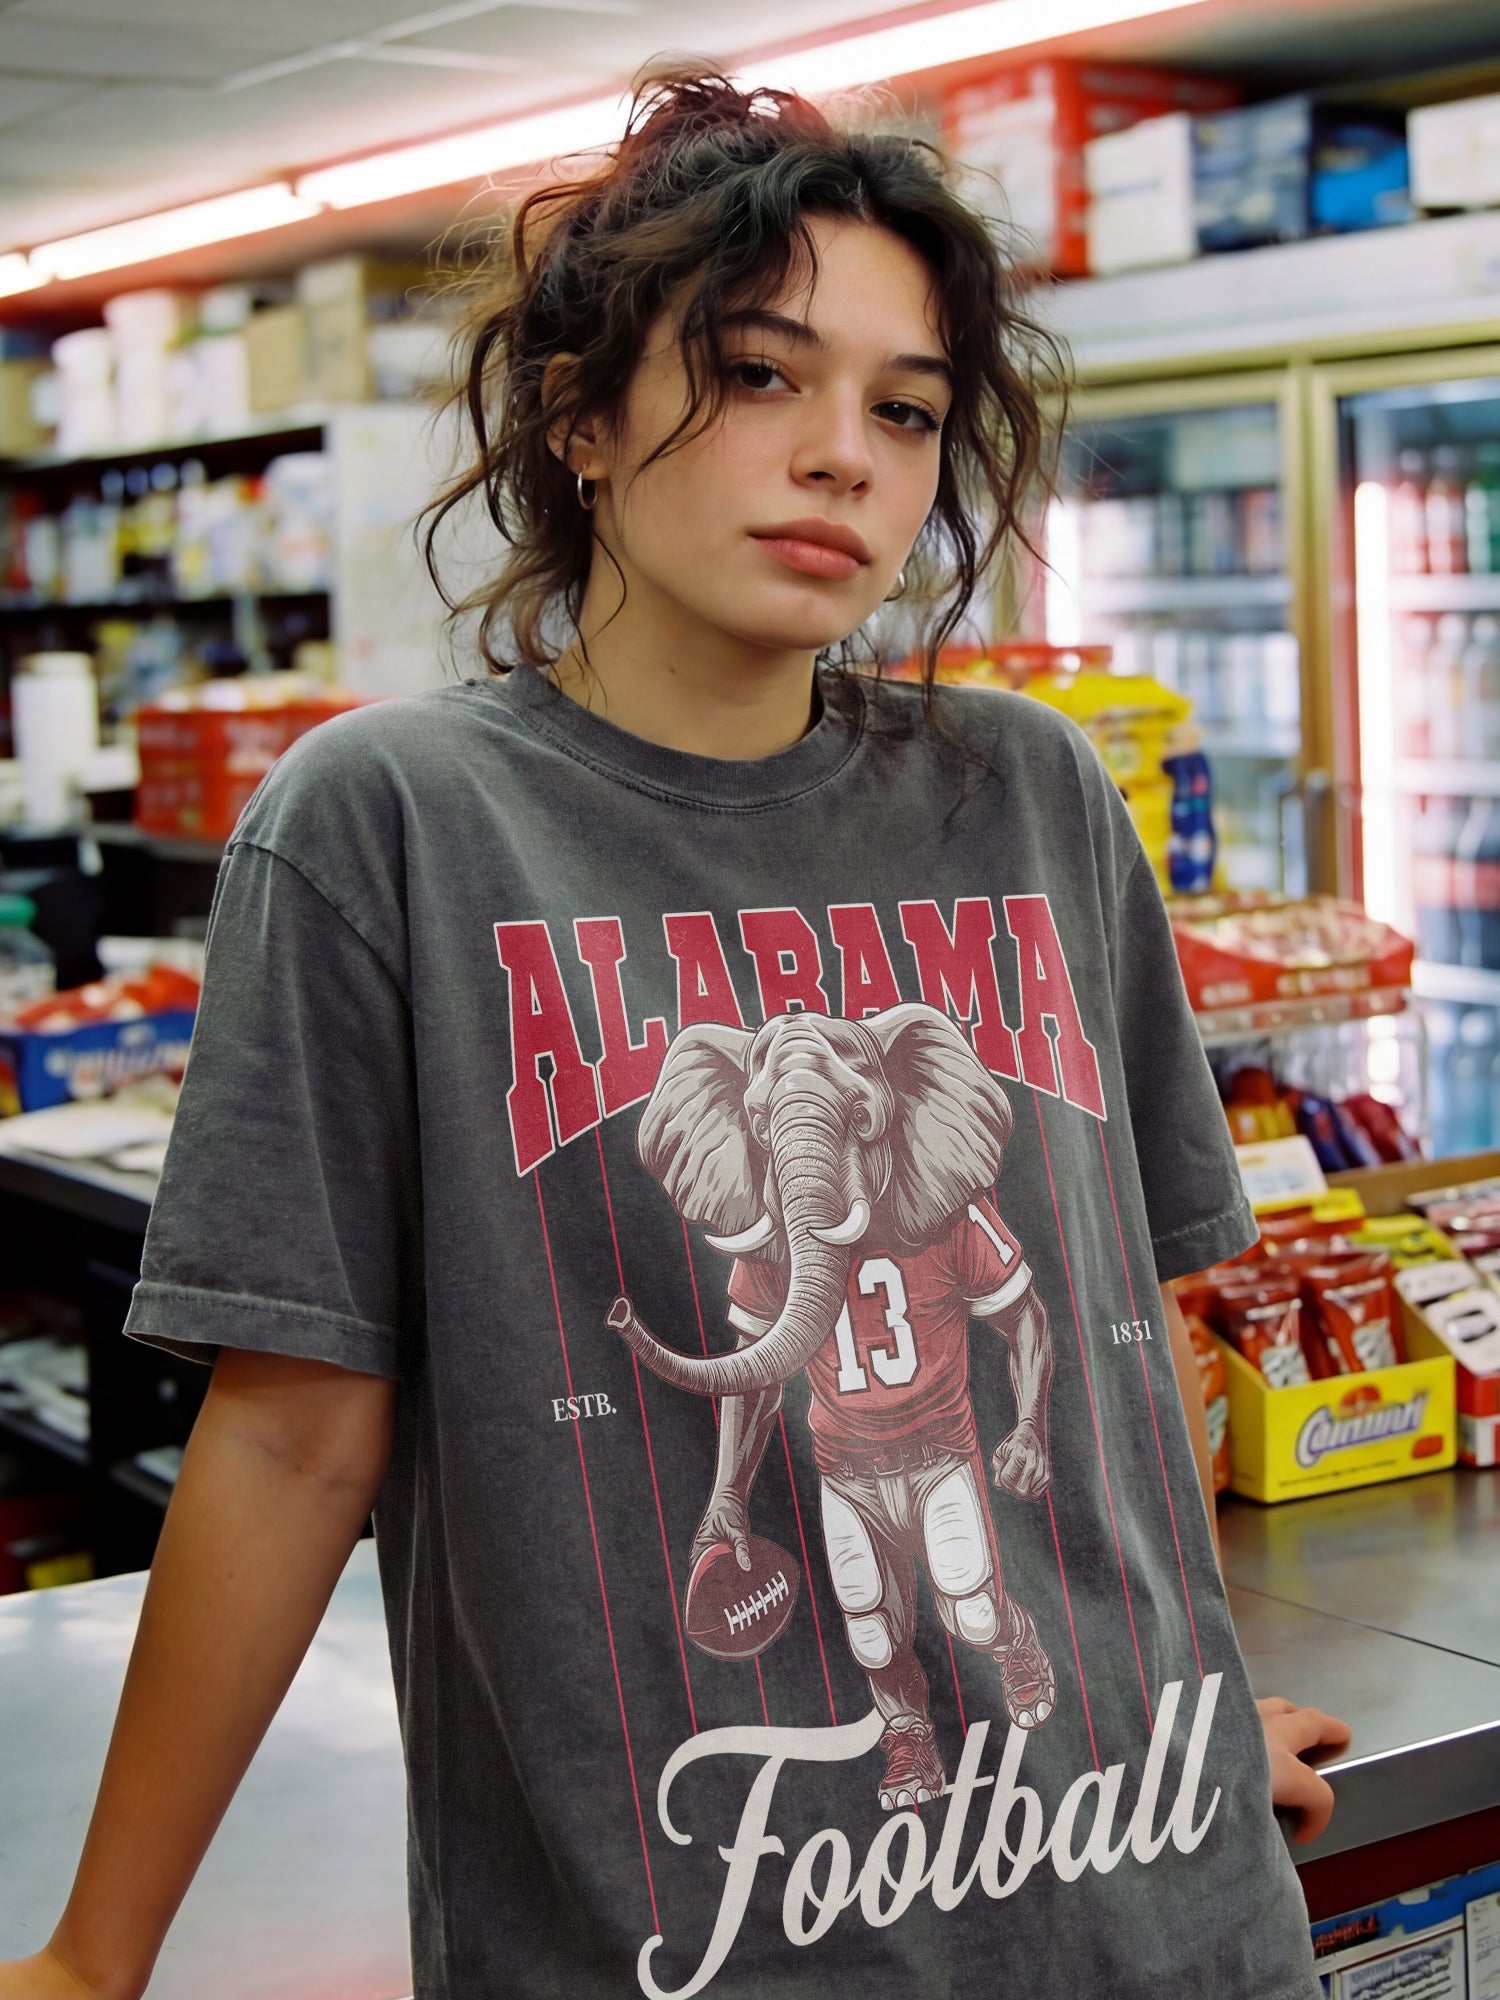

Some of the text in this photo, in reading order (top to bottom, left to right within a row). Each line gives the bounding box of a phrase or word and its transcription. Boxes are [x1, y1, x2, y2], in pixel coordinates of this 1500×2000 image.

[493, 893, 1107, 1178] ALABAMA
[833, 1256, 920, 1394] 13
[1109, 1319, 1154, 1346] 1831
[551, 1392, 618, 1423] ESTB.
[637, 1671, 1224, 2000] Football
